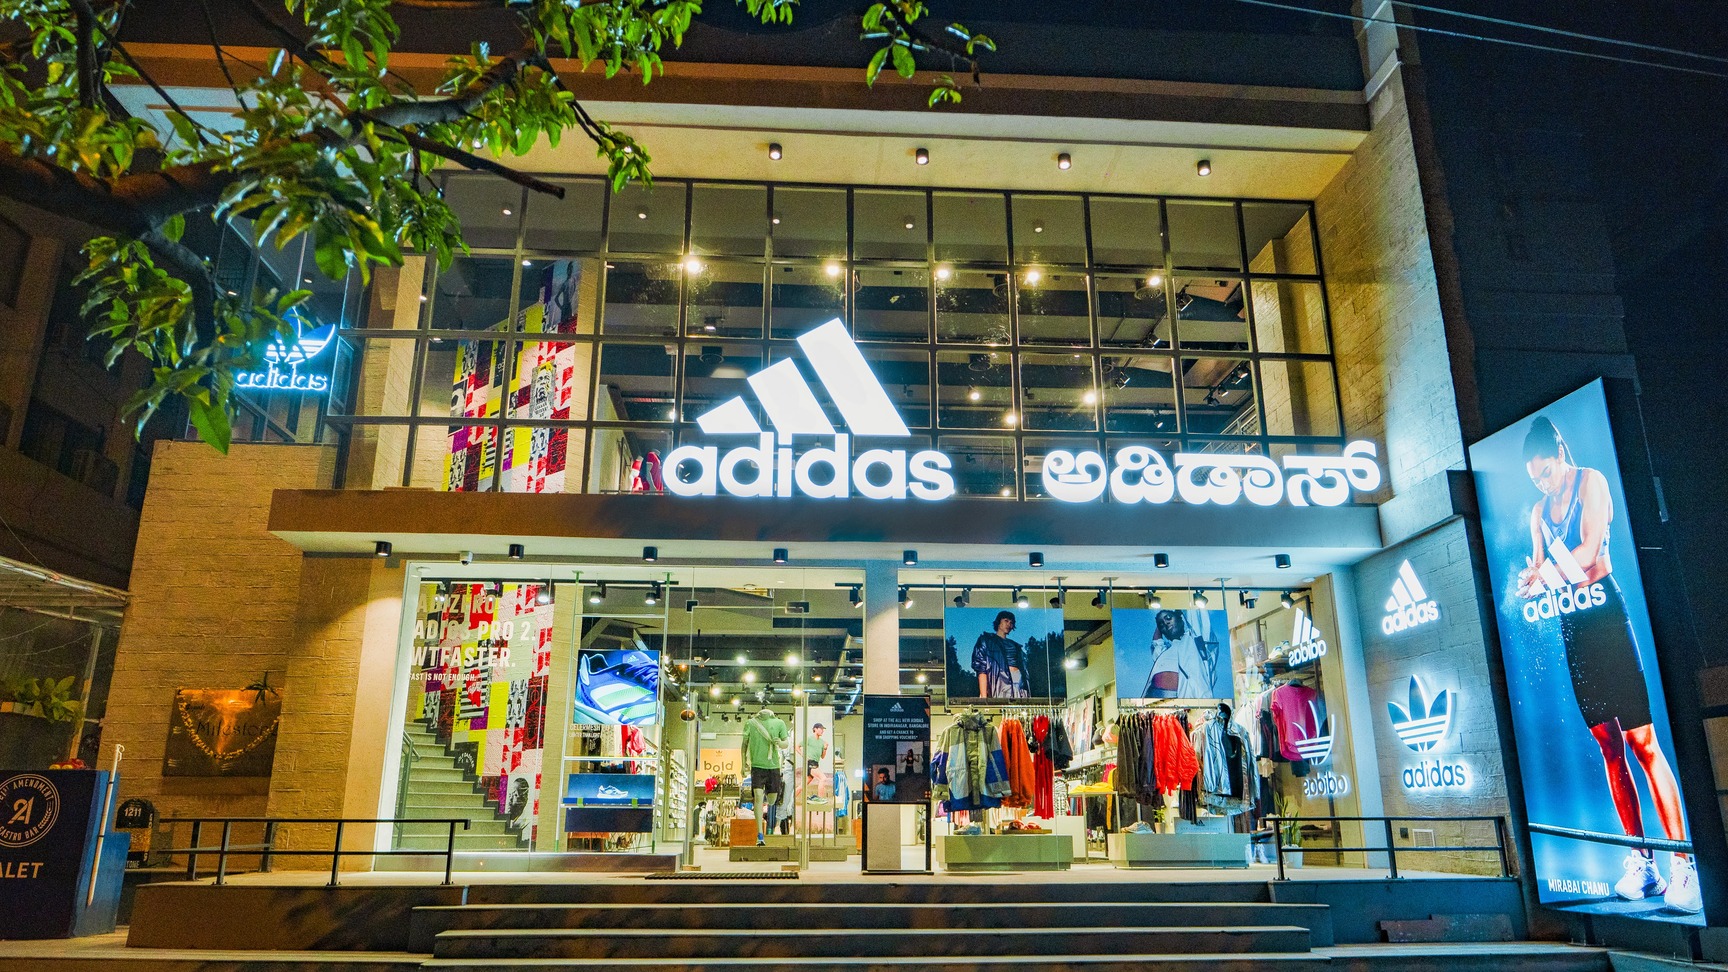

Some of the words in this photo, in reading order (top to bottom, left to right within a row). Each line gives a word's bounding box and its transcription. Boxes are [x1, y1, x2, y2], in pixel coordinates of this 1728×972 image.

[235, 362, 327, 391] adidas
[662, 432, 956, 500] adidas
[1041, 441, 1381, 507] ಅಡಿಡಾಸ್
[1523, 583, 1606, 623] adidas
[1382, 600, 1439, 635] adidas
[477, 620, 514, 641] PRO
[433, 673, 447, 681] NOT
[704, 760, 734, 773] bold
[1402, 759, 1468, 789] adidas
[13, 778, 54, 801] AMENDMENT
[124, 807, 142, 817] 1211
[24, 826, 39, 839] BAR
[0, 862, 44, 878] LET
[1548, 878, 1581, 894] MIRABAI
[1581, 880, 1610, 896] CHANU
